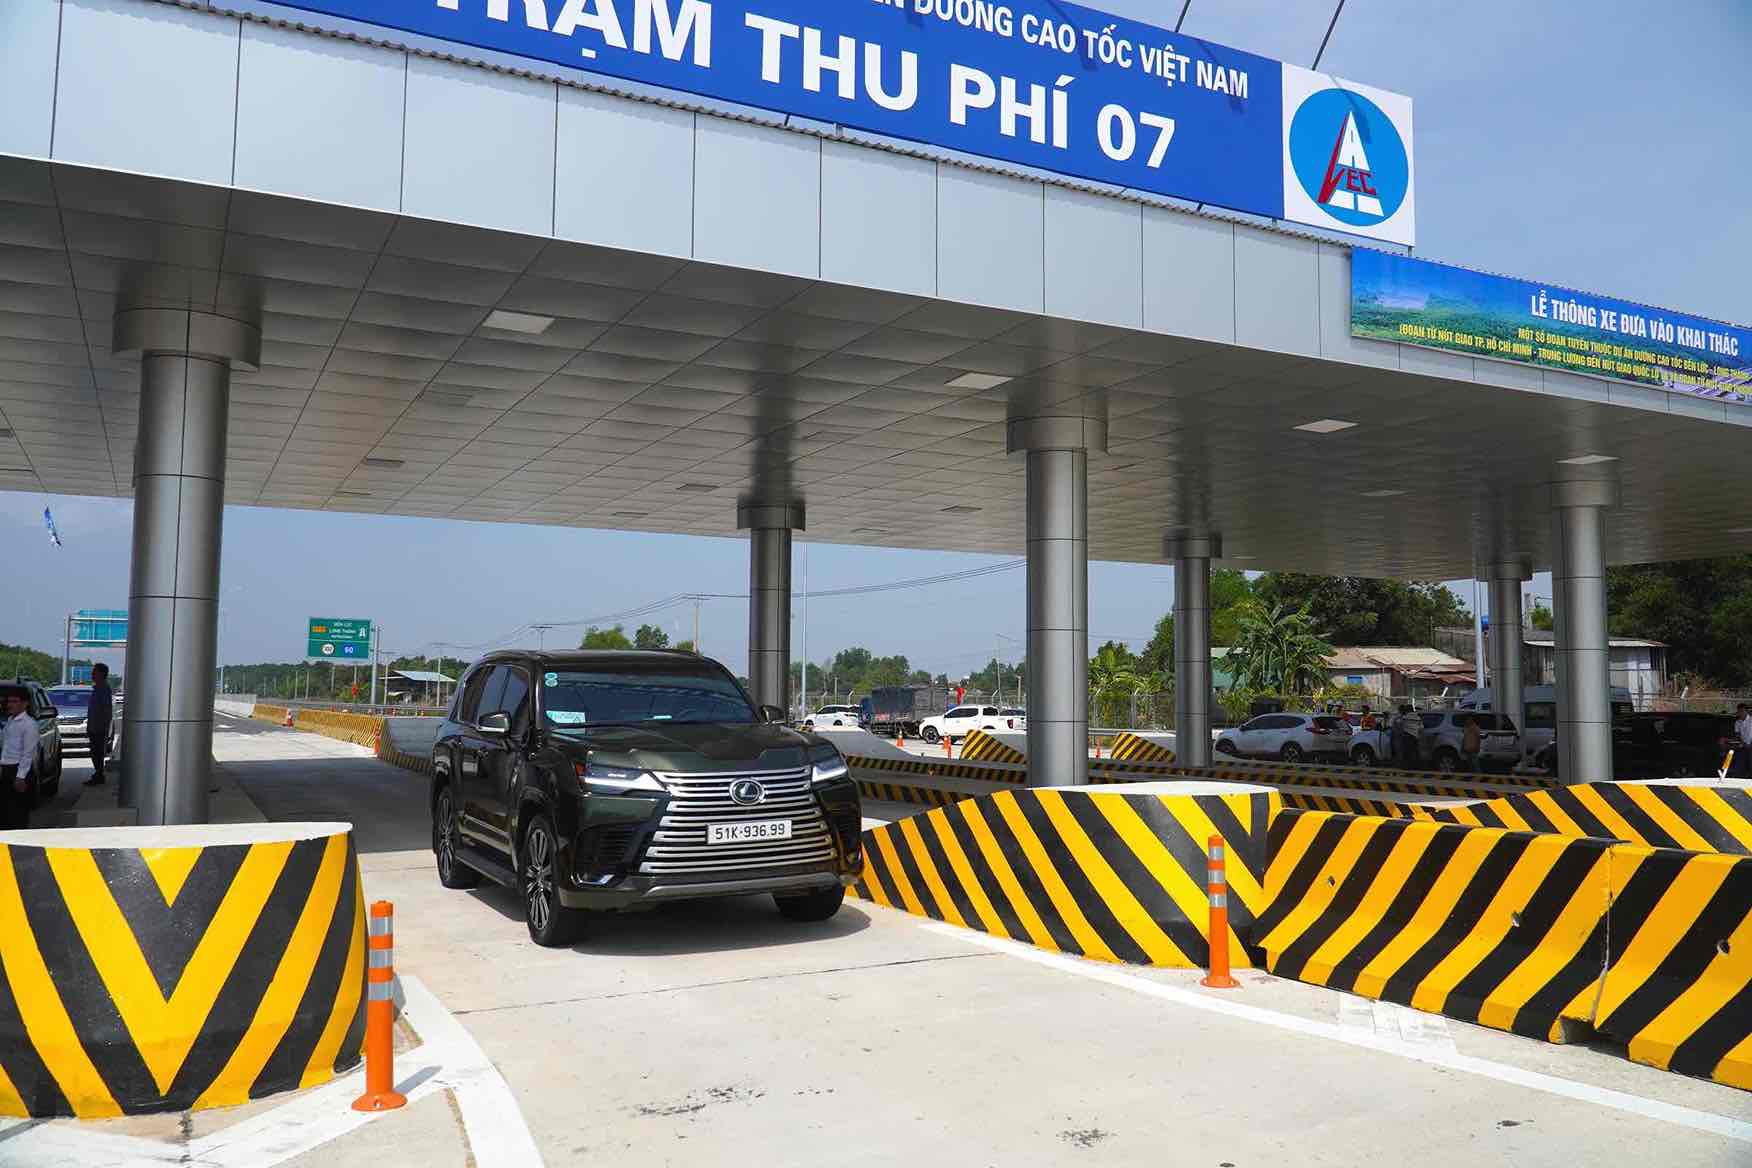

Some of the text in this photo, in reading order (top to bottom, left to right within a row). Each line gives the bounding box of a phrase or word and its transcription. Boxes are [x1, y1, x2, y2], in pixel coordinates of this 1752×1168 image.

[745, 12, 918, 111] THU
[949, 63, 1077, 150] PHÍ
[1096, 104, 1176, 169] 07
[1021, 14, 1076, 54] CAO
[1083, 25, 1132, 69] TỐC
[1139, 44, 1189, 86] VIỆT
[1196, 60, 1249, 99] NAM
[1531, 290, 1739, 357] LỄ THÔNG XE ĐƯA VÀO KHAI THÁC
[715, 823, 785, 840] 51K-936.99
